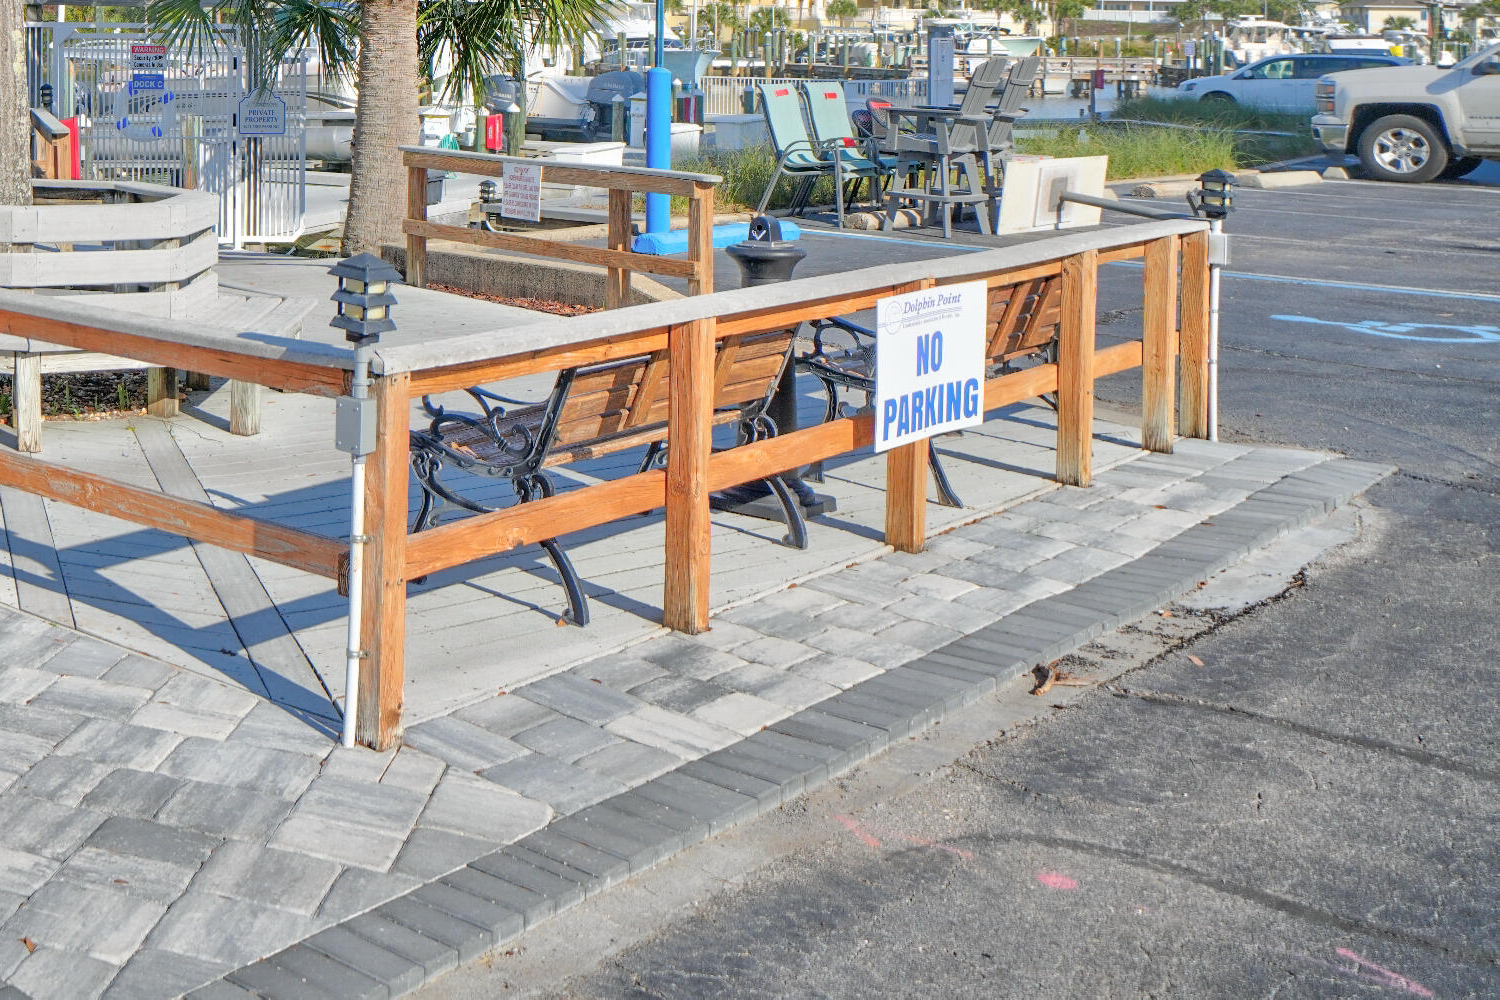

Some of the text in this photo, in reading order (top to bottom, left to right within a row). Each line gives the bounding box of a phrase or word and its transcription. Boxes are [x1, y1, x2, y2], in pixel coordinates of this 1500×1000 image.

[134, 80, 163, 88] DOCK C
[903, 292, 962, 314] Dolphin Point
[916, 330, 943, 377] NO
[882, 377, 979, 442] PARKING
